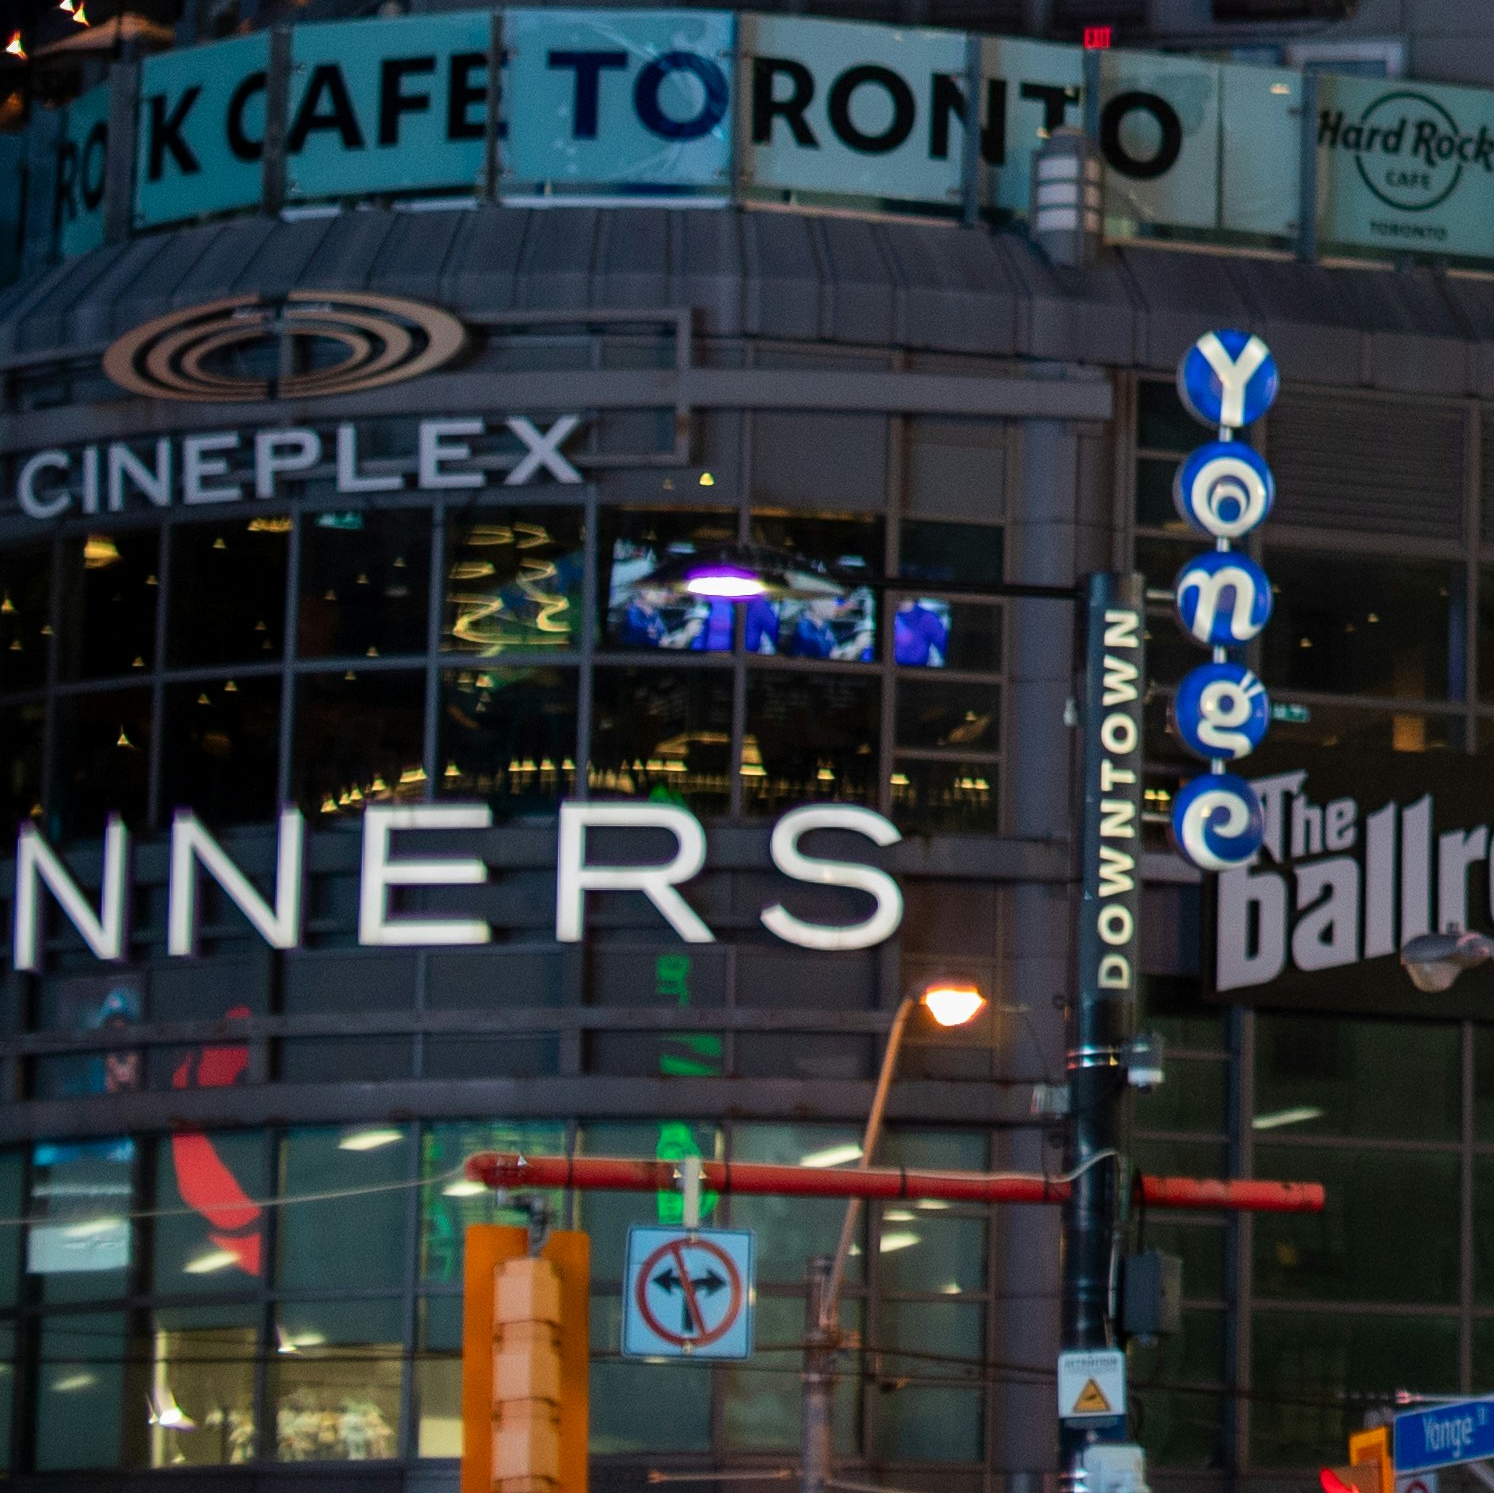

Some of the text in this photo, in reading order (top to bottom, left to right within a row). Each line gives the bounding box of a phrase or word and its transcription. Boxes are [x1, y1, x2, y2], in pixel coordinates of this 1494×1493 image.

[225, 50, 508, 163] CAFE
[547, 48, 1184, 181] TORONTO
[1317, 107, 1407, 155] Hard
[16, 415, 584, 519] CINEPLEX
[1178, 330, 1270, 871] Yonge
[1097, 608, 1142, 991] DOWNTOWN
[1246, 769, 1359, 864] The
[13, 800, 905, 971] NNERS
[1422, 1414, 1474, 1458] Yonge
